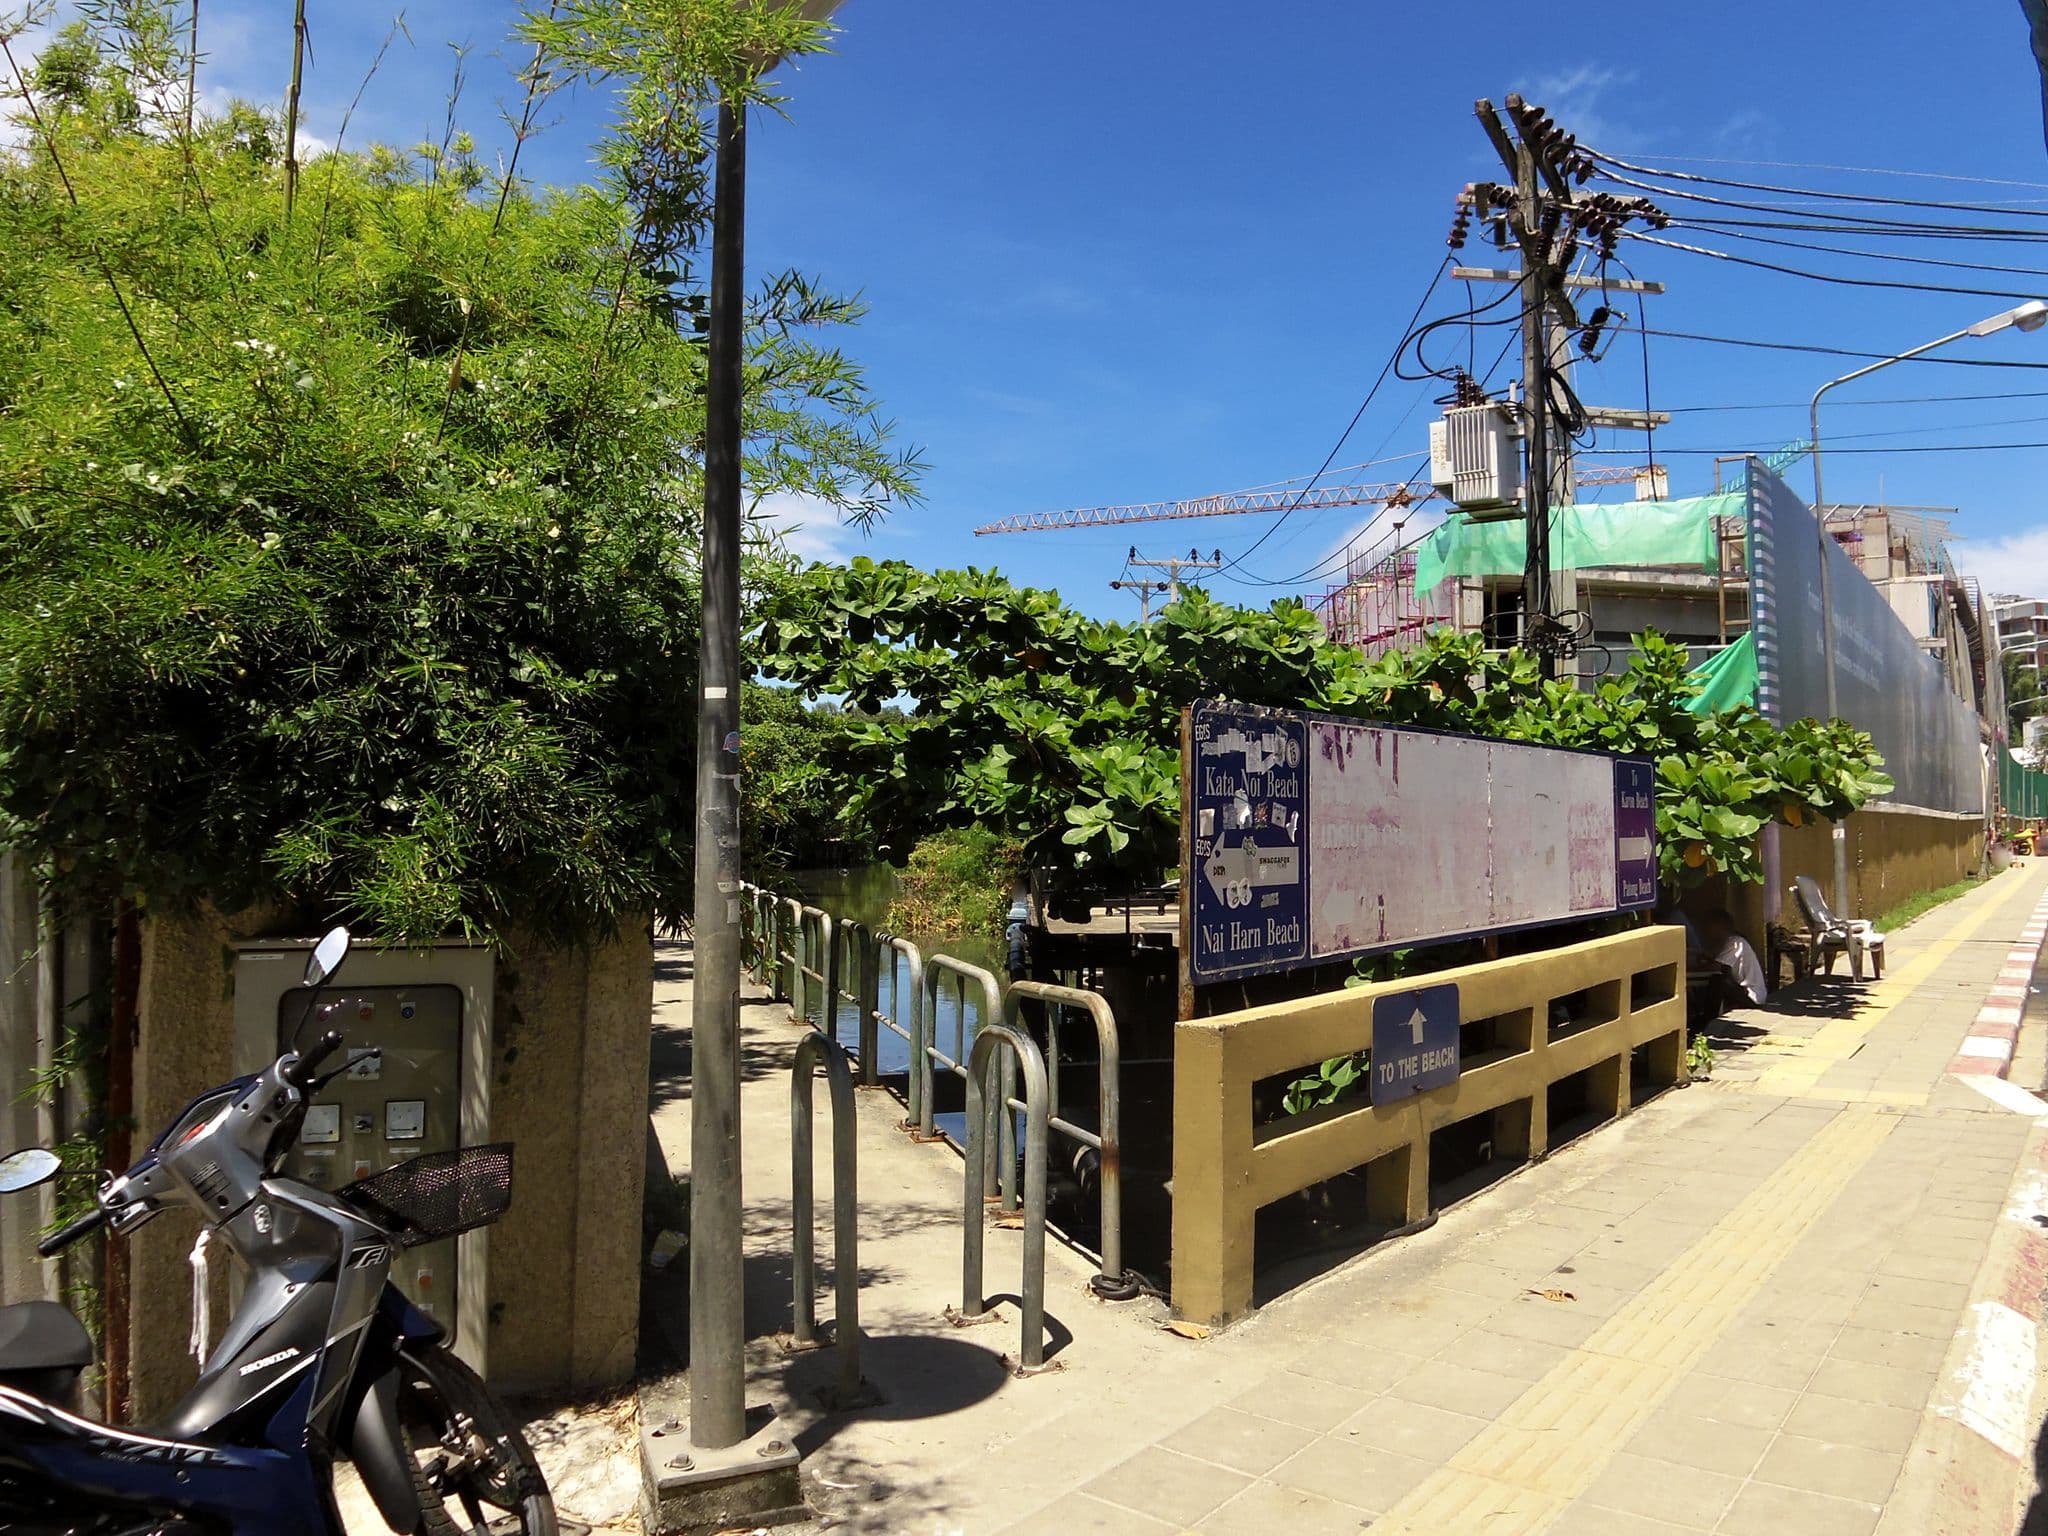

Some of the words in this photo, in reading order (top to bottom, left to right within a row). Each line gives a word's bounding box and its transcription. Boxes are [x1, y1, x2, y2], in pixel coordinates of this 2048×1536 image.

[1205, 767, 1234, 796] Kata
[1241, 769, 1261, 797] Noi
[1266, 770, 1299, 798] Beach
[1202, 923, 1224, 955] Nai
[1230, 921, 1261, 951] Harn
[1267, 916, 1300, 946] Beach
[1379, 1062, 1395, 1085] TO
[1398, 1055, 1418, 1080] THE
[1422, 1046, 1454, 1073] BEACH
[239, 1347, 300, 1376] HONDA
